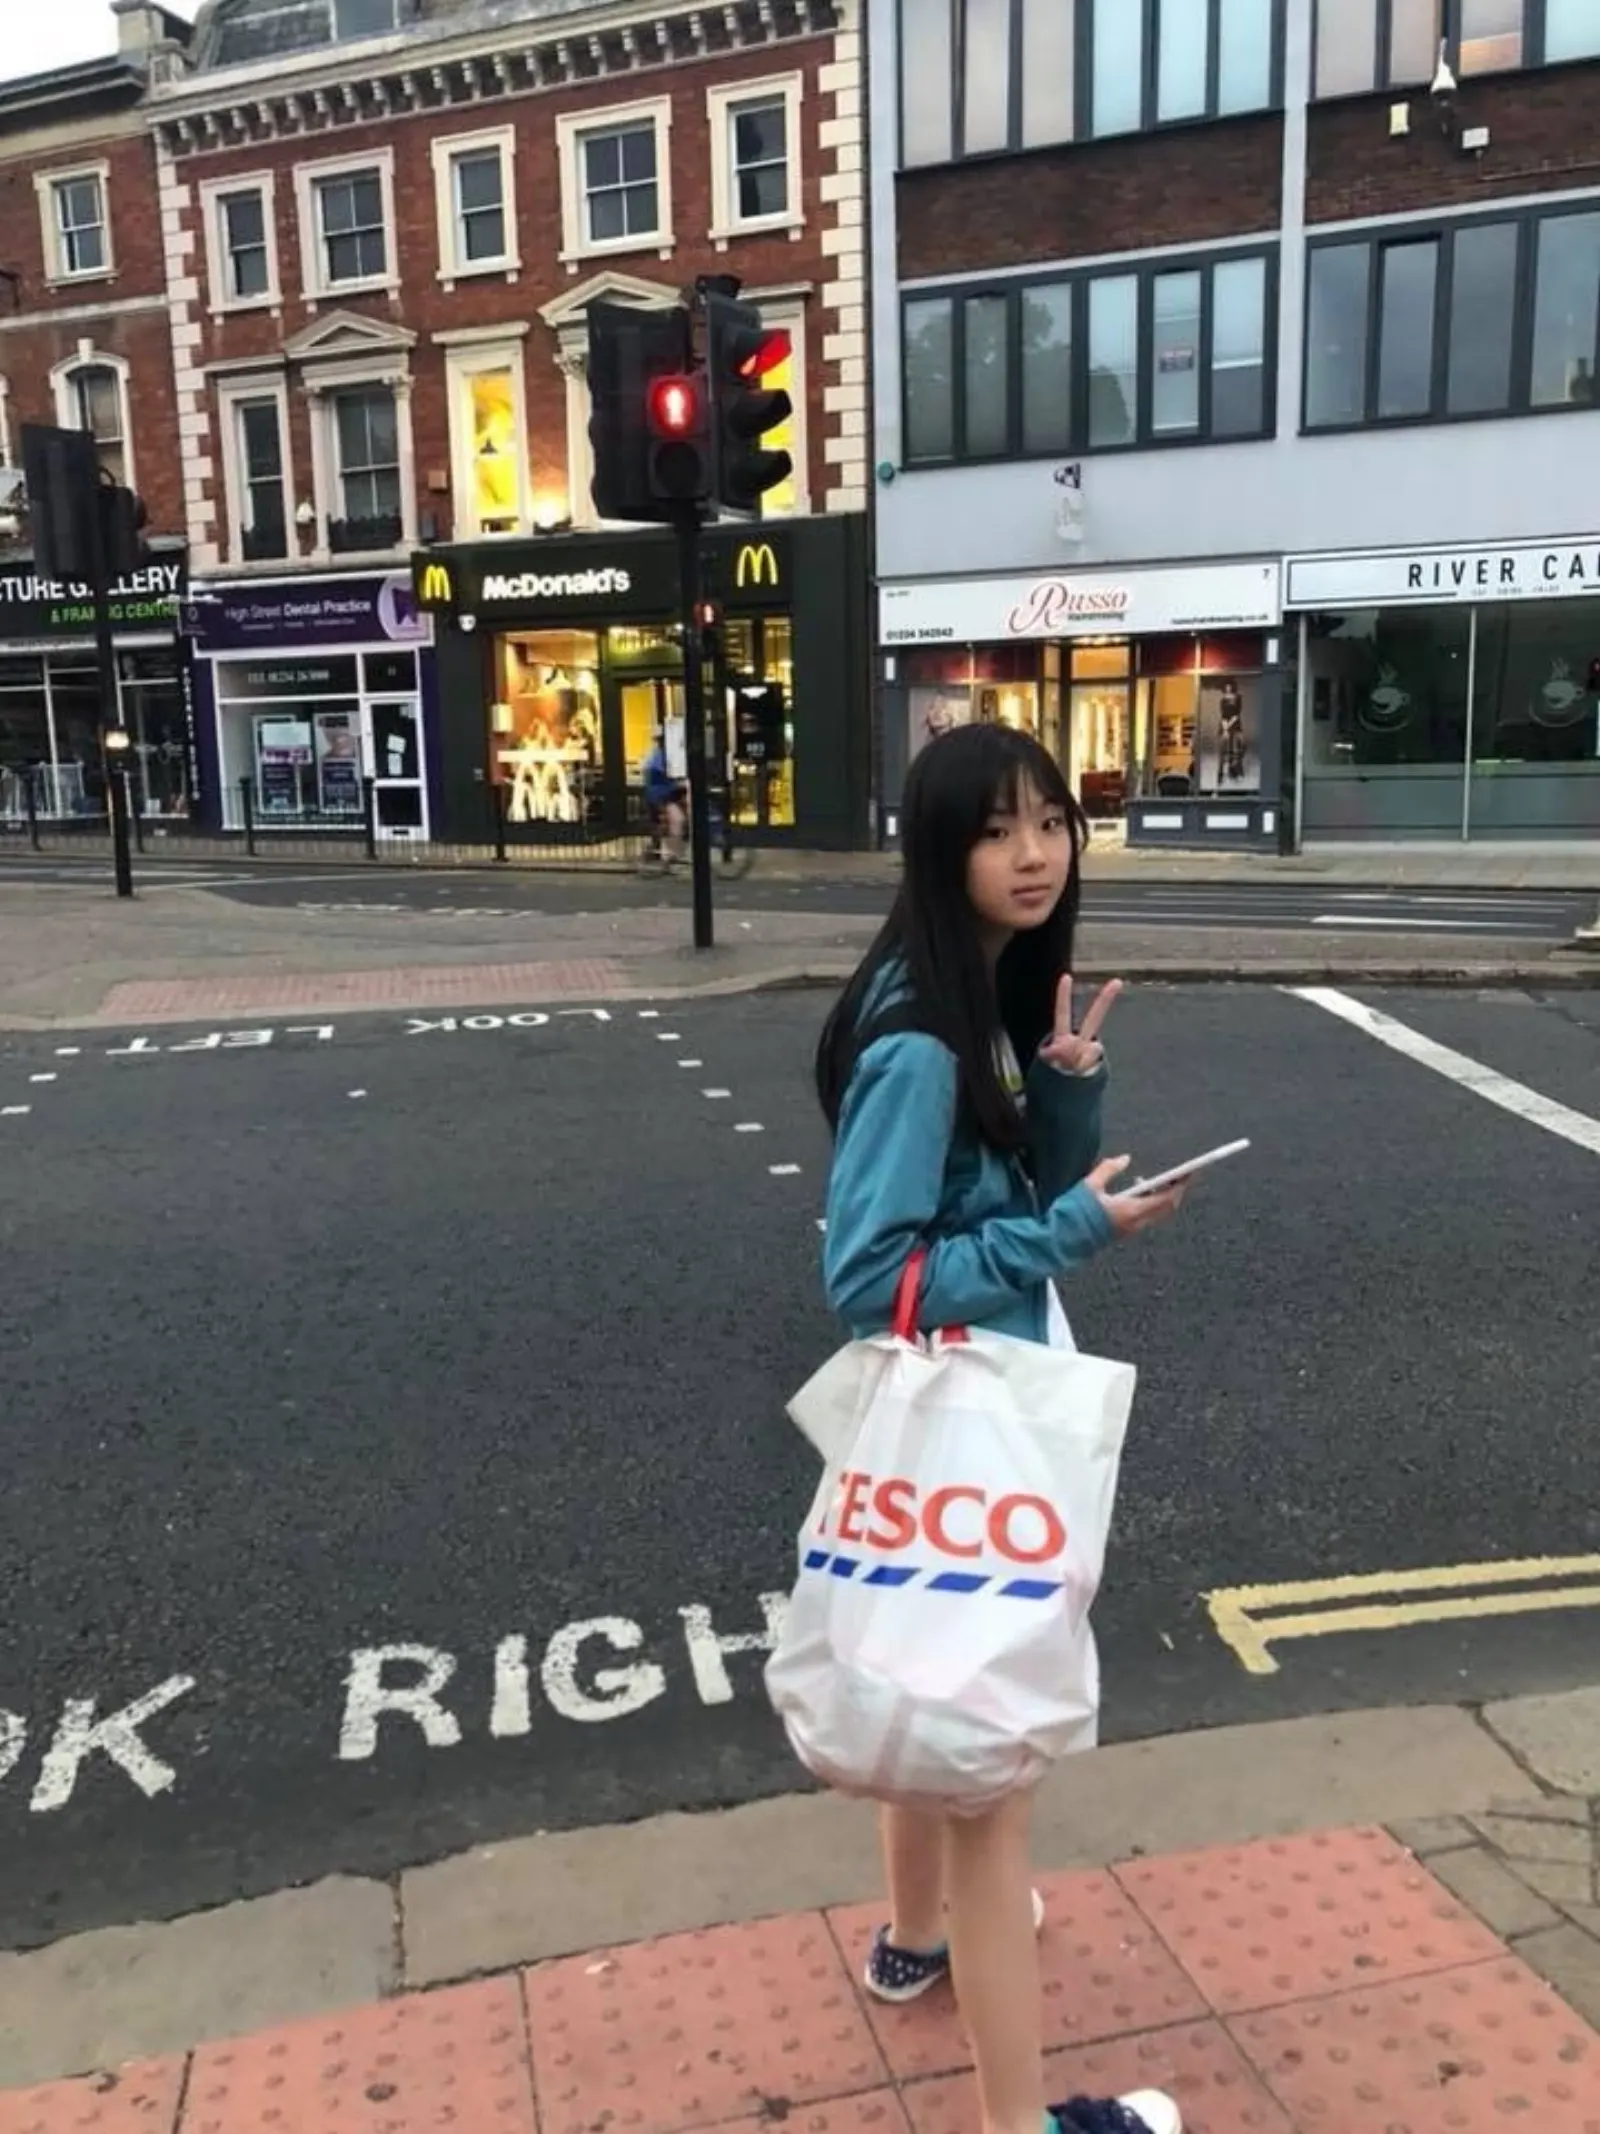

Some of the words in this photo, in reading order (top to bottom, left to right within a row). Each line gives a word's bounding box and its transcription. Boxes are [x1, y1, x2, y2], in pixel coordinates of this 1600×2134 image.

[0, 575, 66, 602] TURE
[69, 564, 179, 598] GLERY
[482, 568, 631, 600] McDonald's
[1408, 557, 1515, 588] RIVER
[1542, 552, 1600, 581] CA
[283, 601, 321, 617] Dental
[323, 599, 371, 614] Practice
[1008, 581, 1128, 633] Russo
[405, 1008, 612, 1035] LOOK
[106, 1024, 335, 1056] LEFT
[338, 1590, 797, 1760] RIGH
